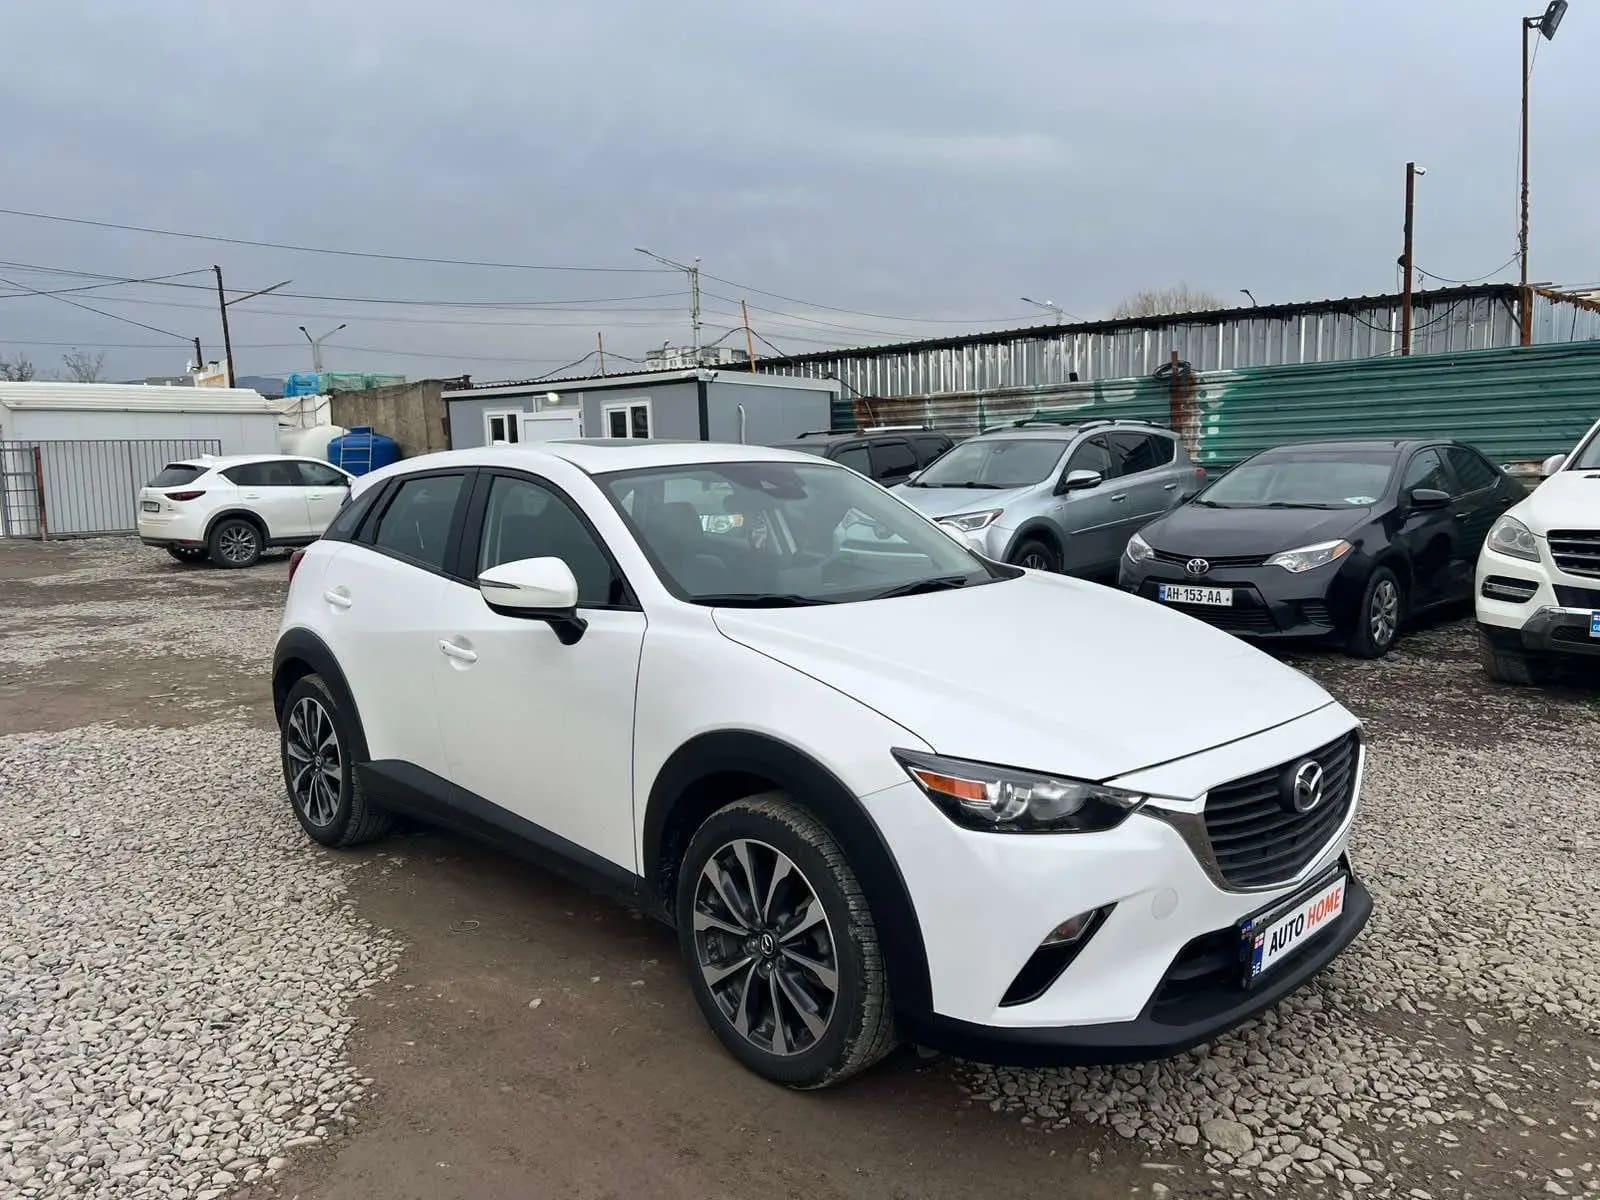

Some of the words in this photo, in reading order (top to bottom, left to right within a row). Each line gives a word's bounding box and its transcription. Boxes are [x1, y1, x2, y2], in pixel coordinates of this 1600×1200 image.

[1167, 587, 1221, 603] AH-153-AA
[1269, 914, 1304, 956] AUTO
[1307, 887, 1341, 928] HOME
